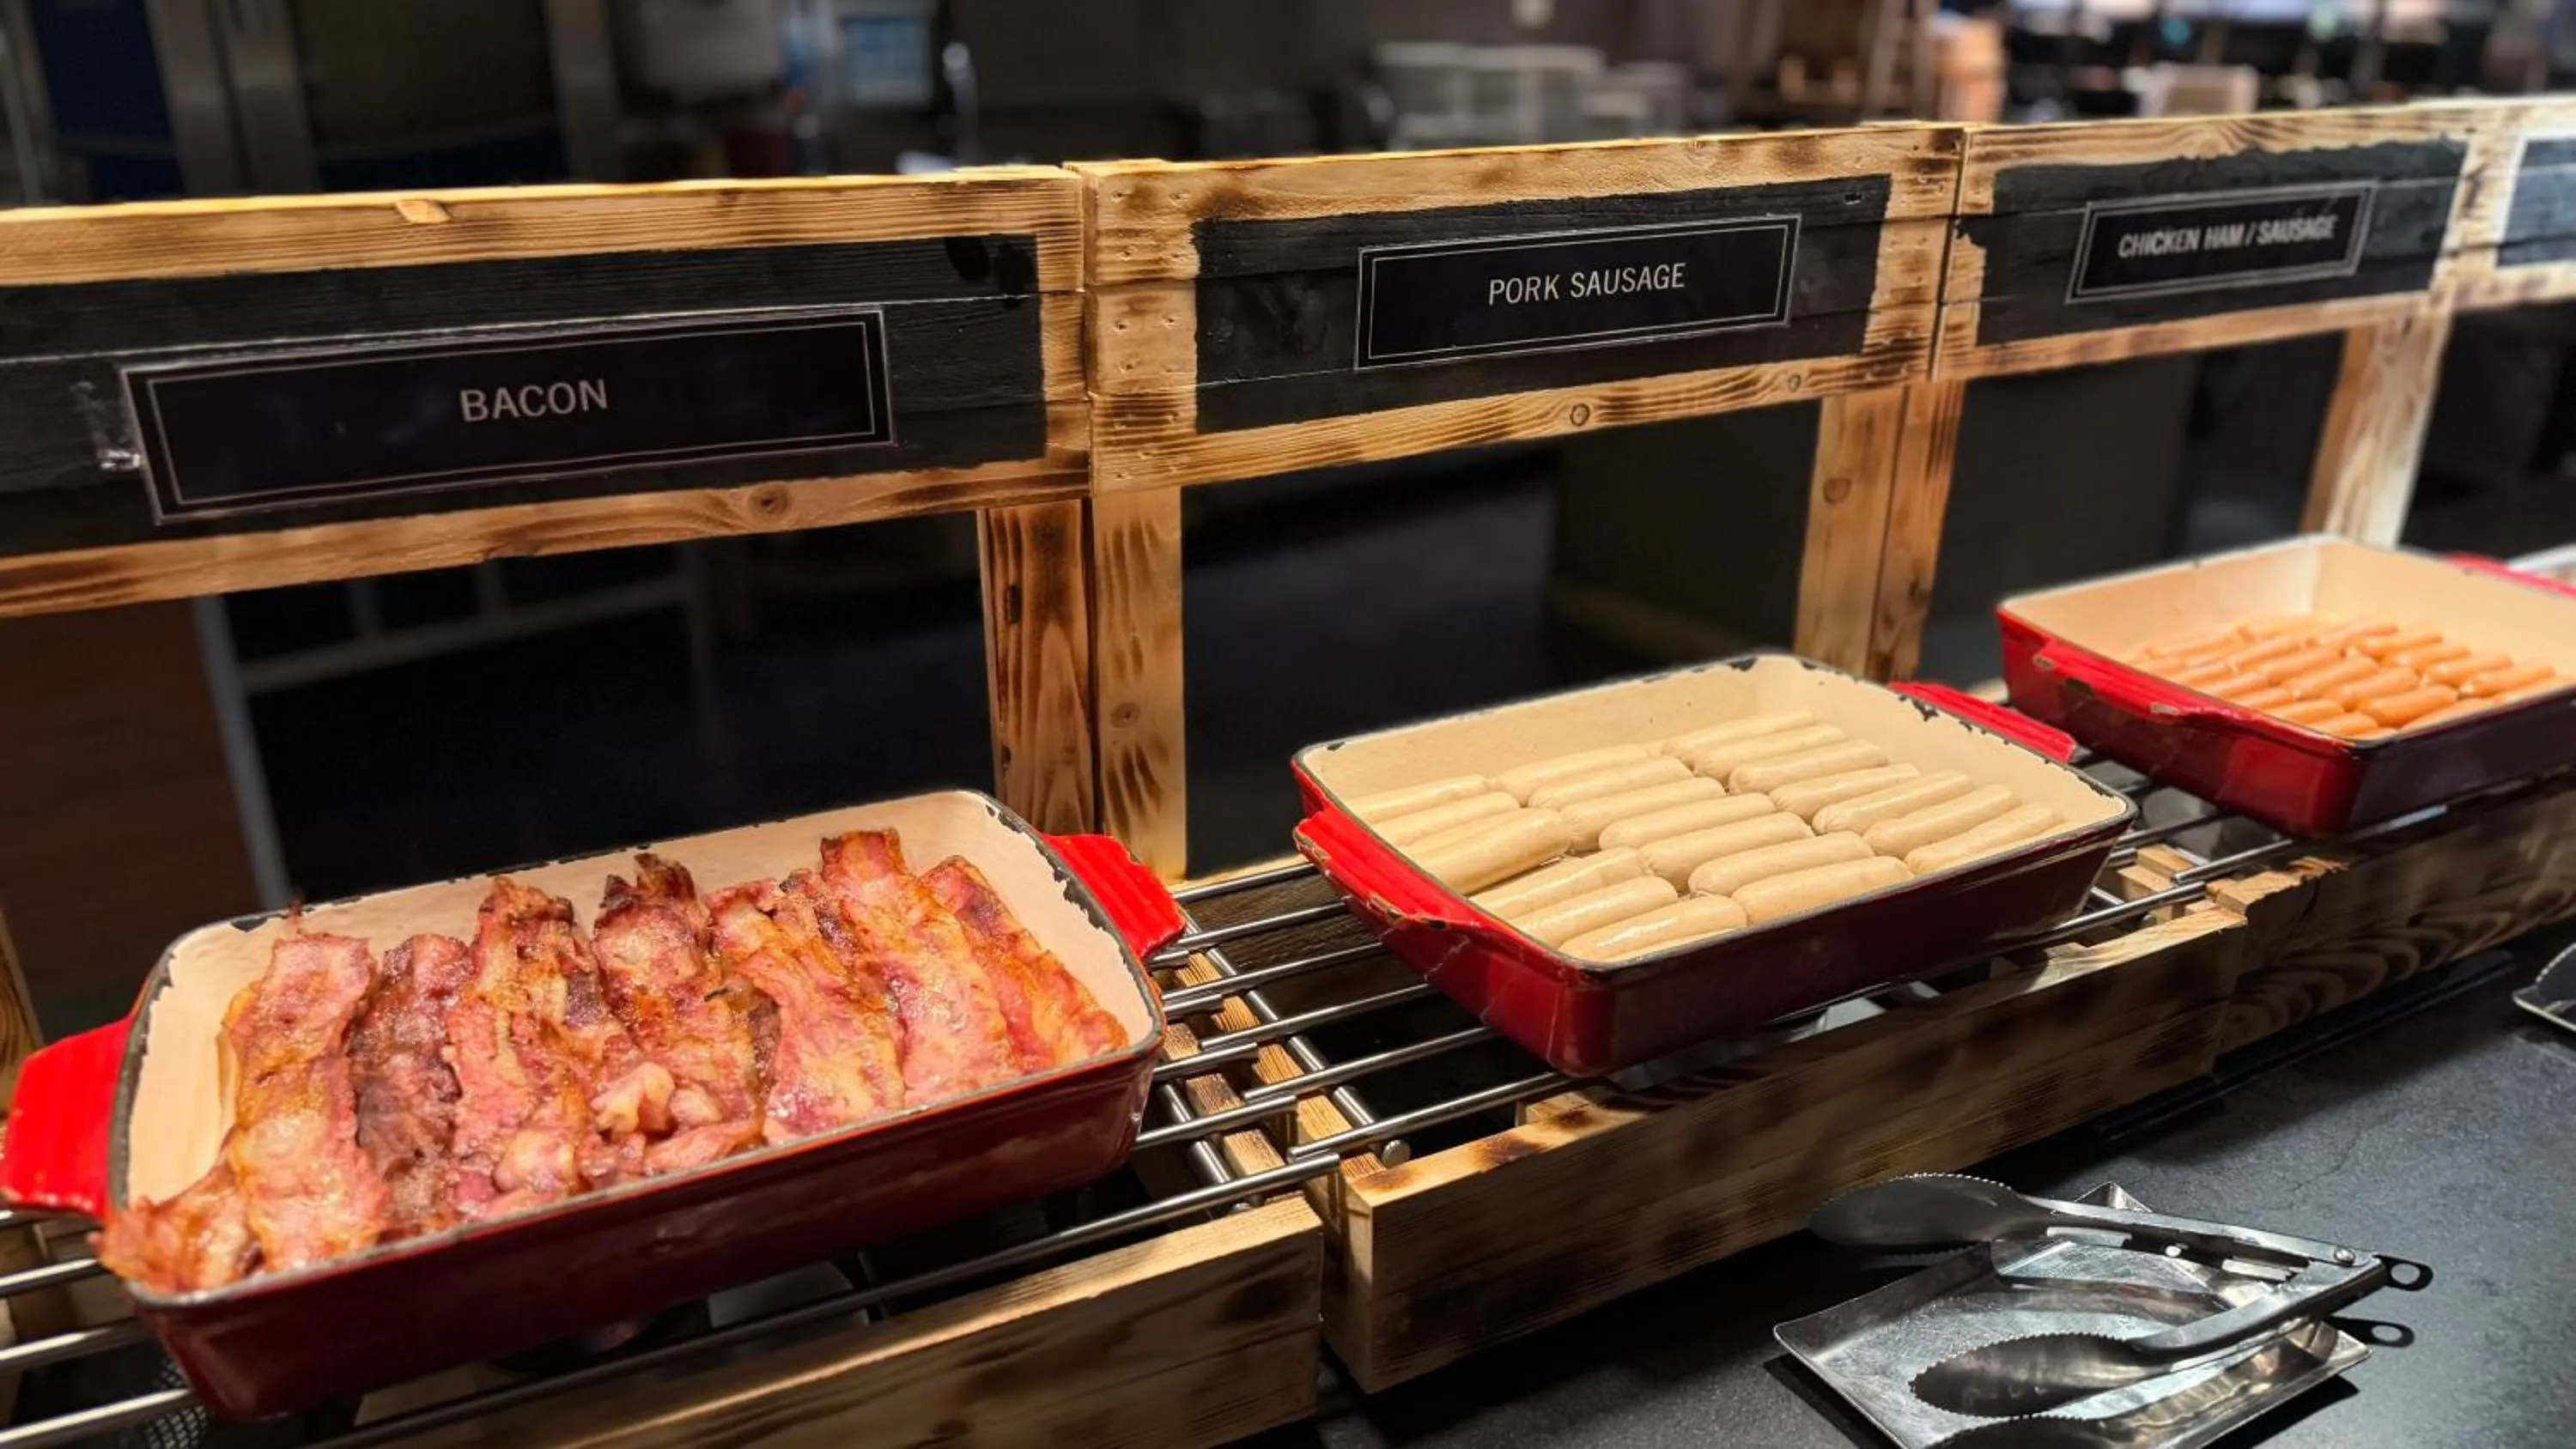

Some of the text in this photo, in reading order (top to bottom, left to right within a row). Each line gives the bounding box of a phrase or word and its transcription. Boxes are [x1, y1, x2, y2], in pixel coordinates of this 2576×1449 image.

[2117, 227, 2201, 258] CHICKEN
[2203, 223, 2245, 251] HAM
[2256, 215, 2338, 246] SAUSAGE
[1488, 262, 1686, 306] PORK SAUSAGE
[459, 378, 608, 422] BACON
